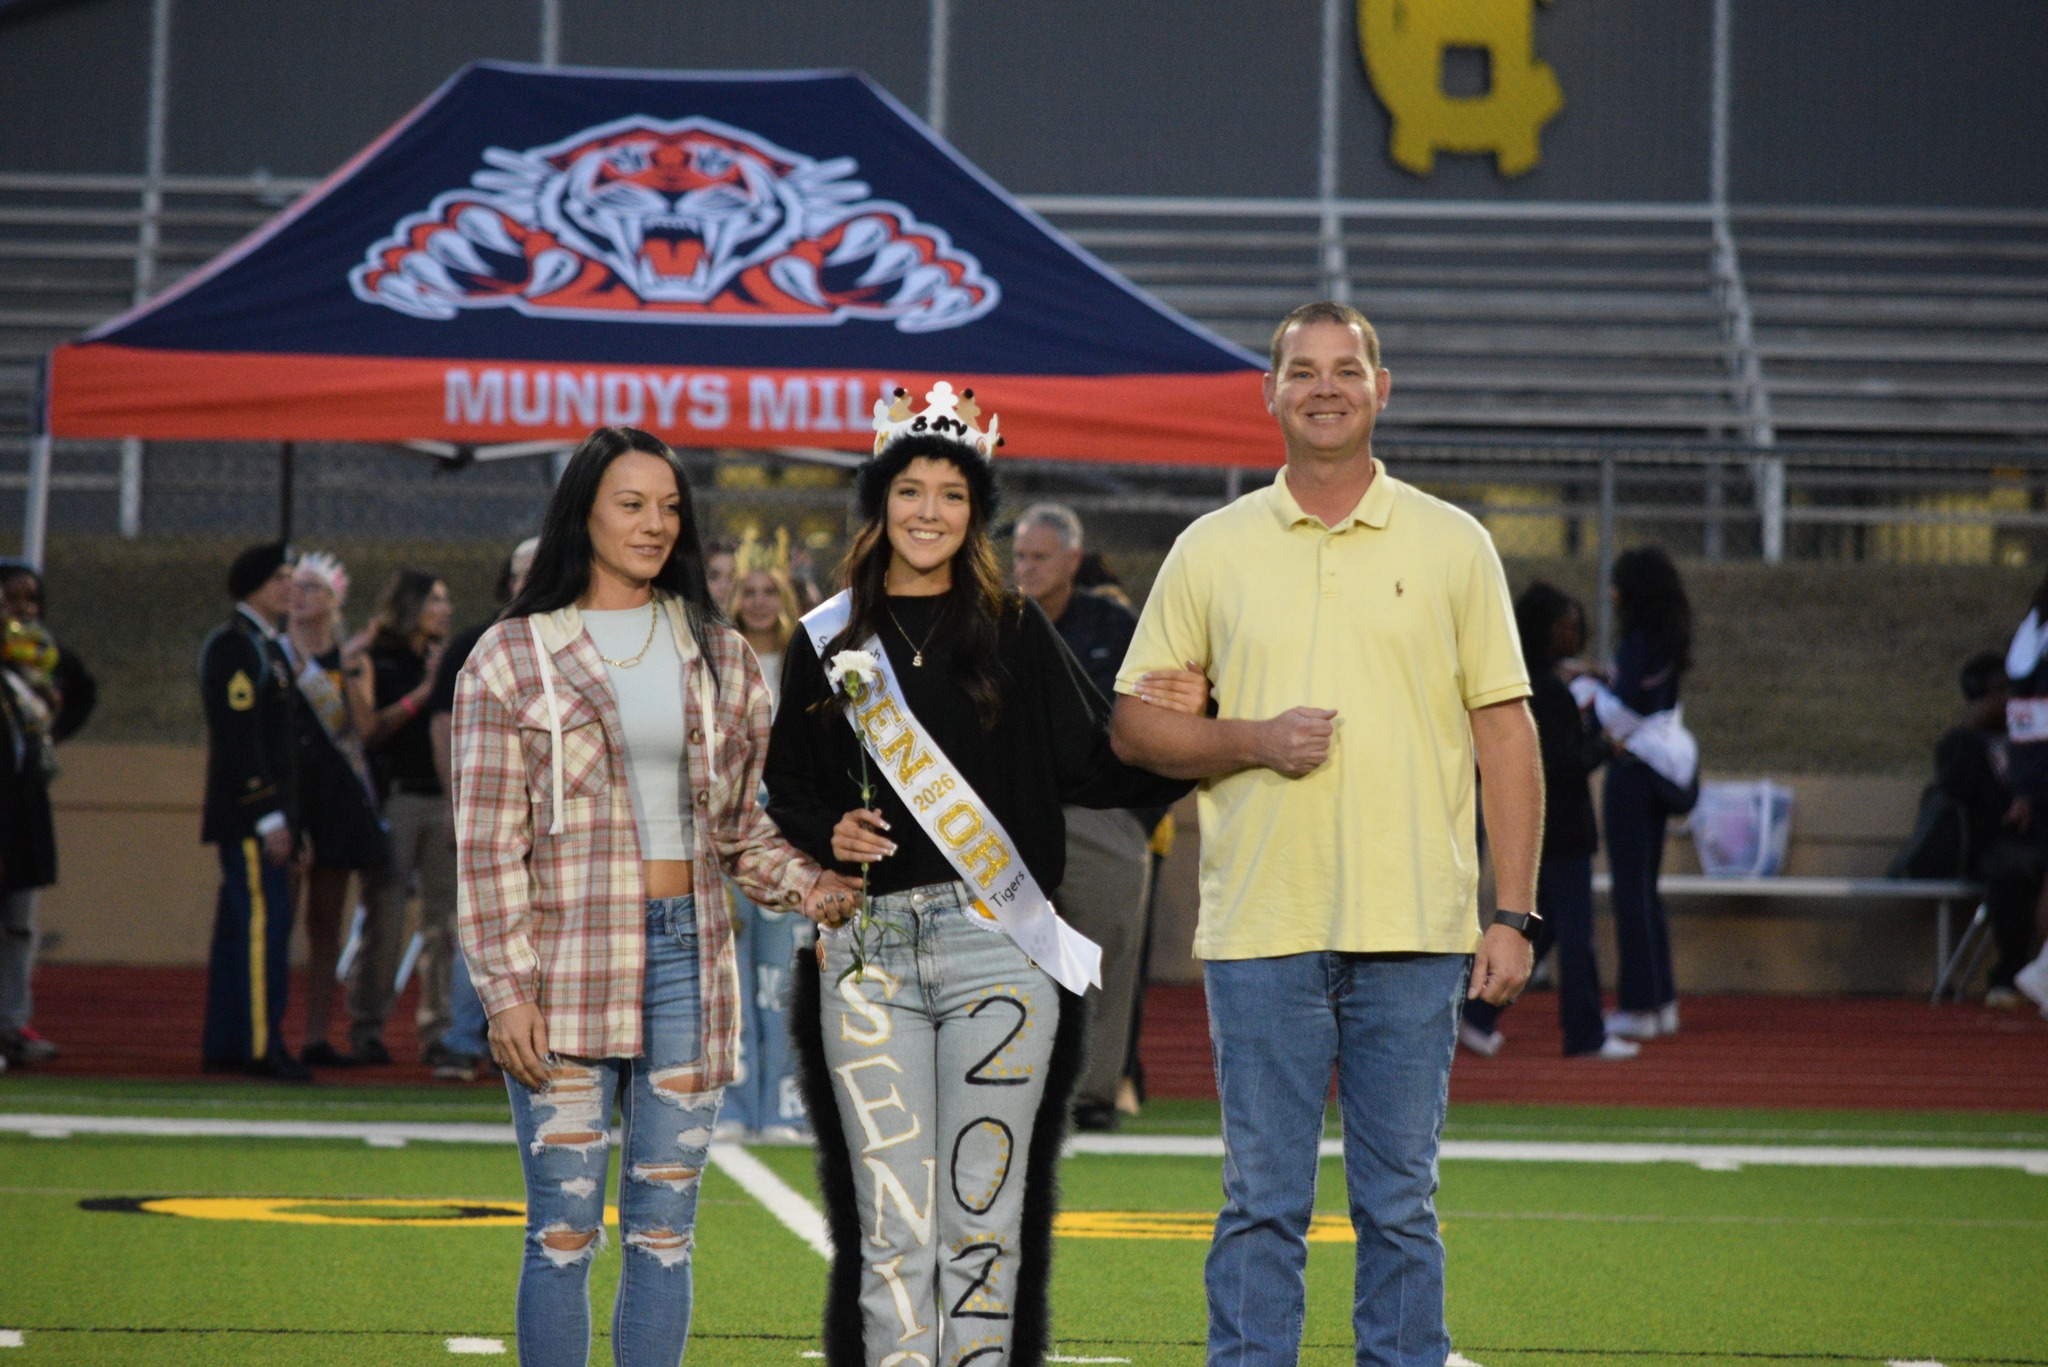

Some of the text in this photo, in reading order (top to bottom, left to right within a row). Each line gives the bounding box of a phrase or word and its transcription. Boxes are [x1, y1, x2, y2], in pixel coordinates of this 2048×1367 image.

[444, 368, 730, 429] MUNDYS
[912, 655, 923, 667] S
[912, 773, 956, 813] 2026
[933, 799, 1011, 891] OR
[989, 871, 1025, 908] Tigers
[835, 963, 937, 1367] SENI
[950, 995, 1030, 1367] 202
